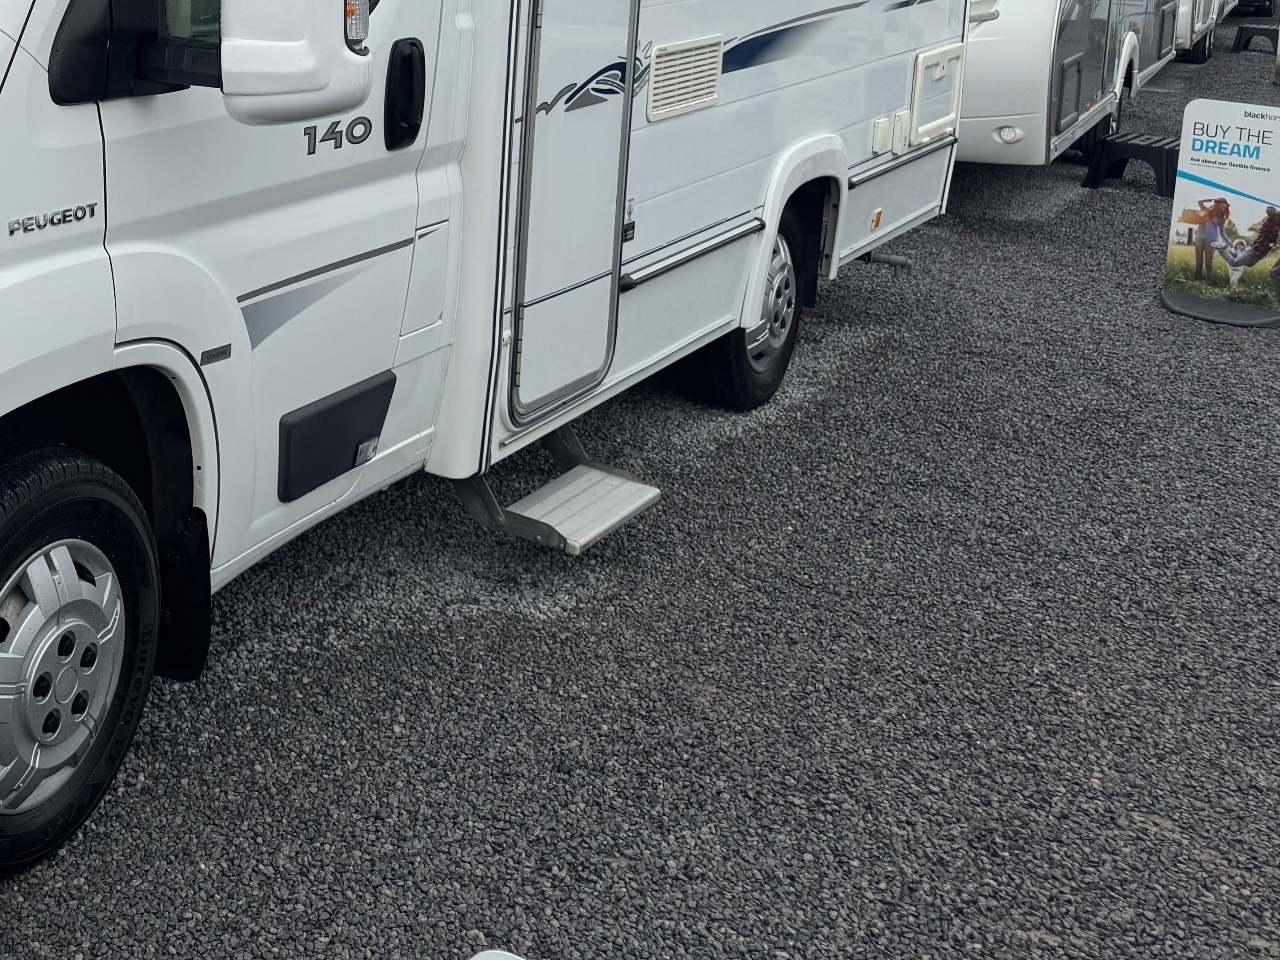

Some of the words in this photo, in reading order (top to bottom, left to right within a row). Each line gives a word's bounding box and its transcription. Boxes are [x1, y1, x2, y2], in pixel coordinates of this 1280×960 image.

[303, 116, 373, 156] 140
[1192, 121, 1231, 140] BUY
[1235, 126, 1274, 146] THE
[1191, 137, 1261, 160] DREAM
[1229, 161, 1249, 170] flexible
[1249, 164, 1271, 173] finance
[8, 202, 98, 236] PEUGEOT
